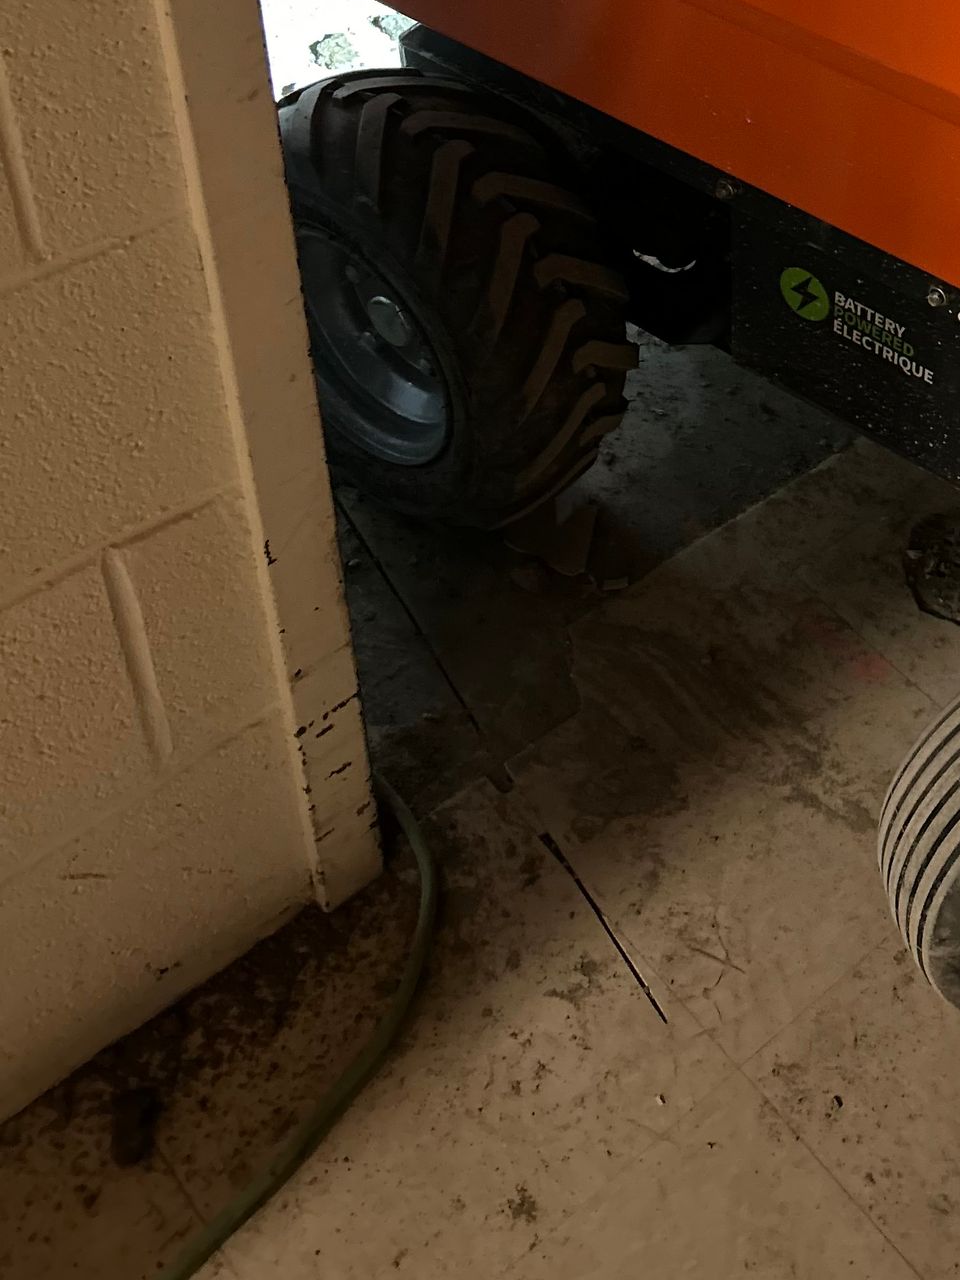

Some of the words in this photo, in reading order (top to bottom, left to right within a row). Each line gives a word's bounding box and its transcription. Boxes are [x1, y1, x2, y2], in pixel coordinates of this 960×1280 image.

[833, 305, 915, 357] POWERED
[834, 291, 906, 338] BATTERY
[832, 318, 934, 385] ÉLECTRIQUE
